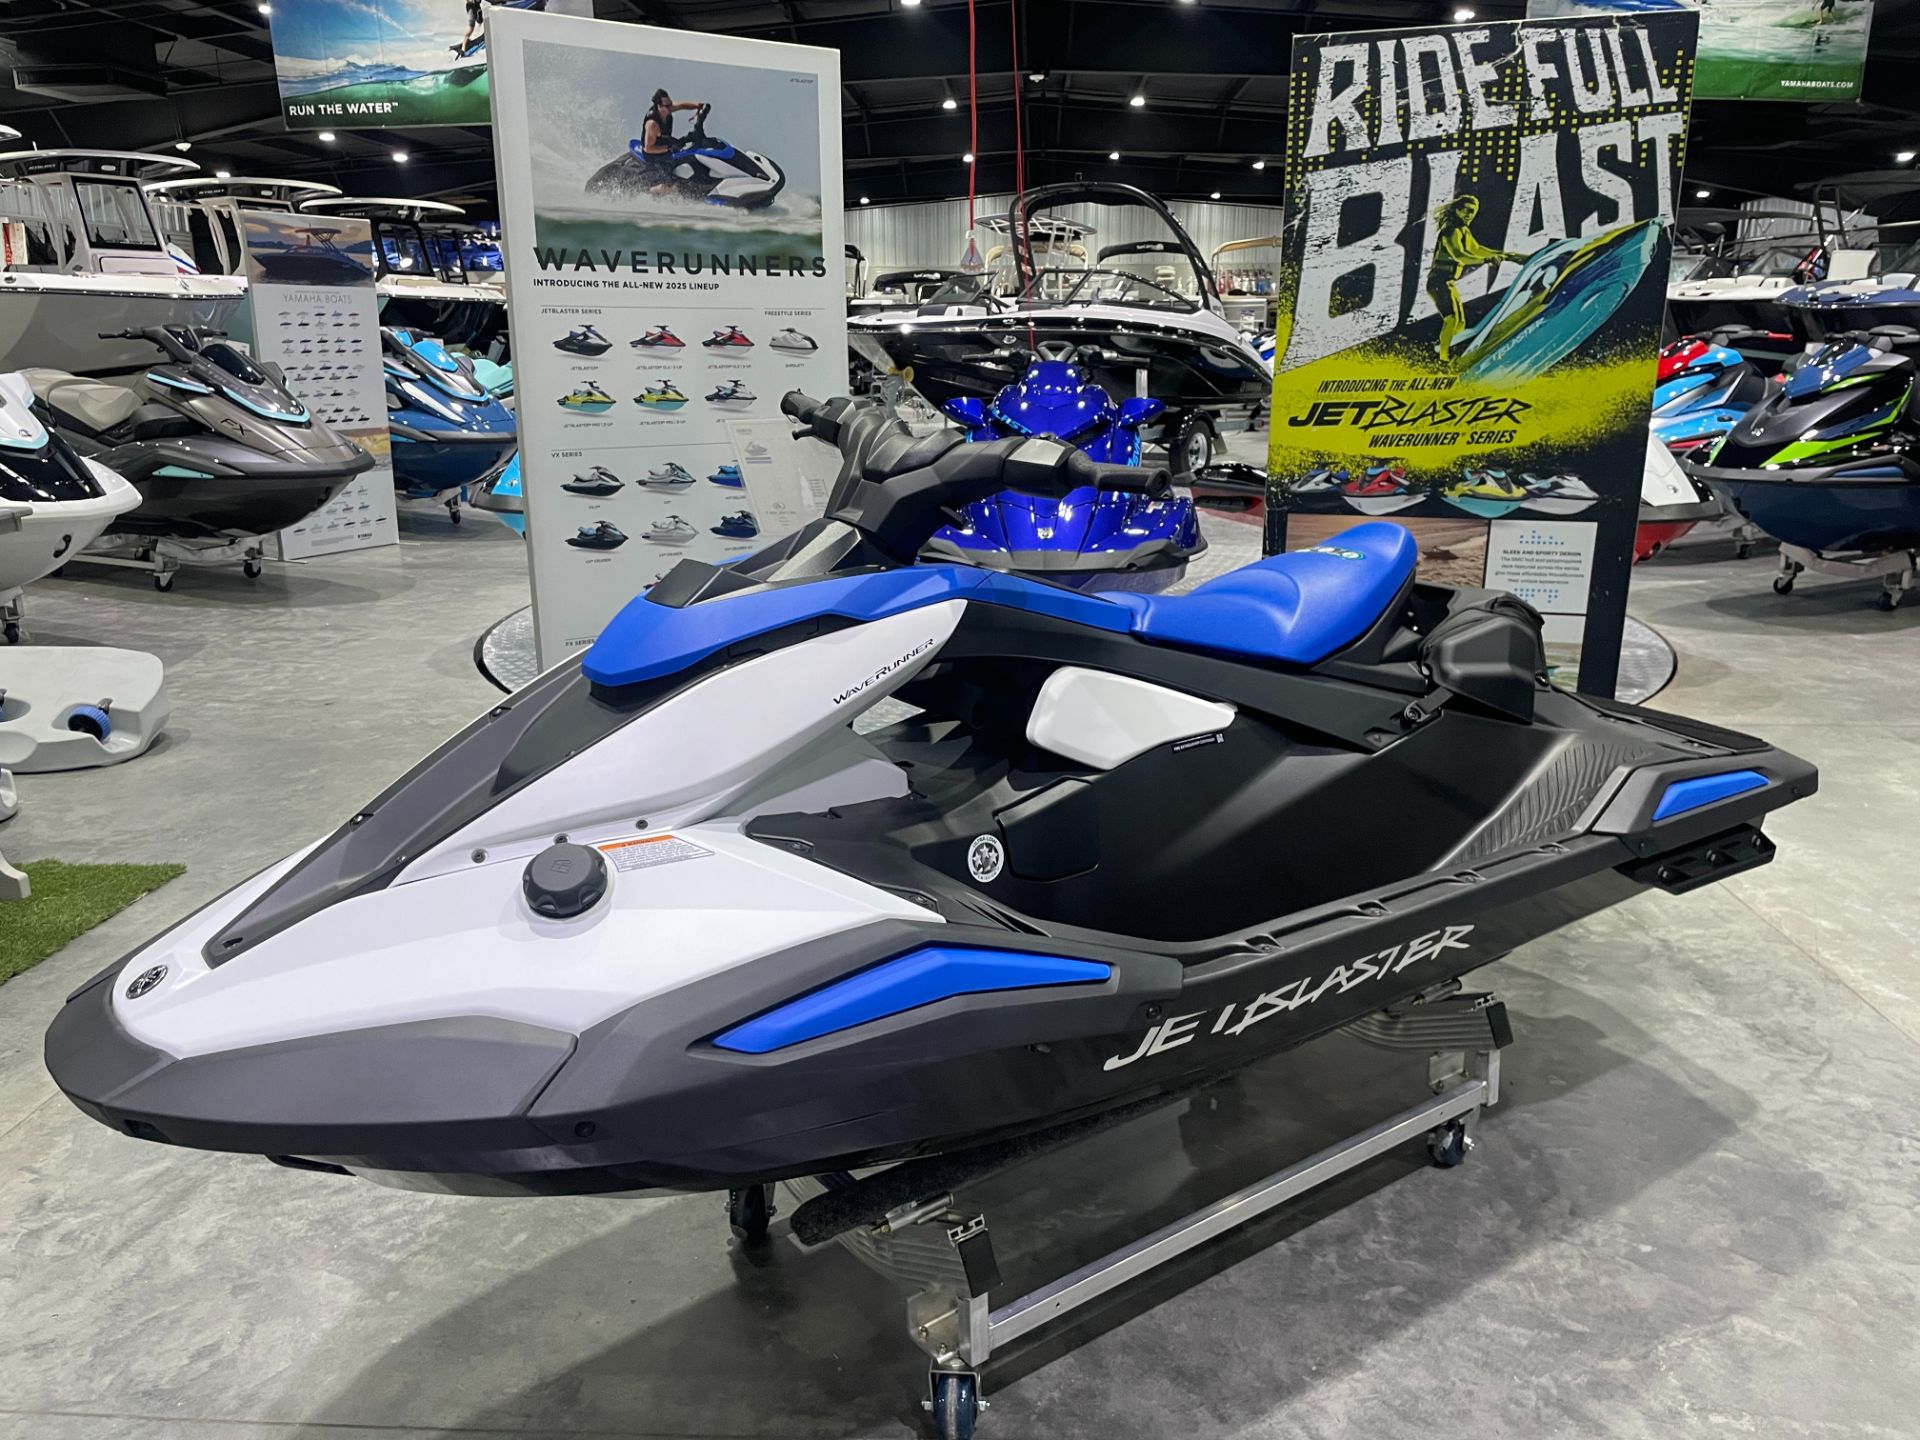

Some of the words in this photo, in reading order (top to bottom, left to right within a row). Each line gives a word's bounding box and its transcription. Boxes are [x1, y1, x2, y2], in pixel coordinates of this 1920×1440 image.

[1780, 80, 1854, 88] YAMAHABOATS.COM
[1303, 29, 1518, 158] RIDE
[1520, 27, 1678, 121] FULL
[289, 105, 315, 116] RUN
[318, 103, 343, 115] THE
[1281, 112, 1683, 368] BLAST
[533, 247, 827, 278] WAVERUNNERS
[533, 278, 599, 288] INTRODUCING
[602, 280, 619, 288] THE
[622, 281, 663, 289] ALL-NEW
[666, 282, 687, 290] 2025
[690, 283, 720, 291] LINEUP
[283, 294, 322, 304] YAMAHA
[325, 295, 353, 305] BOATS
[1317, 378, 1386, 393] INTRODUCING
[1389, 379, 1406, 392] THE
[1407, 376, 1457, 392] ALL-NEW
[1288, 394, 1532, 432] JETBLASTER
[1467, 430, 1517, 445] SERIES
